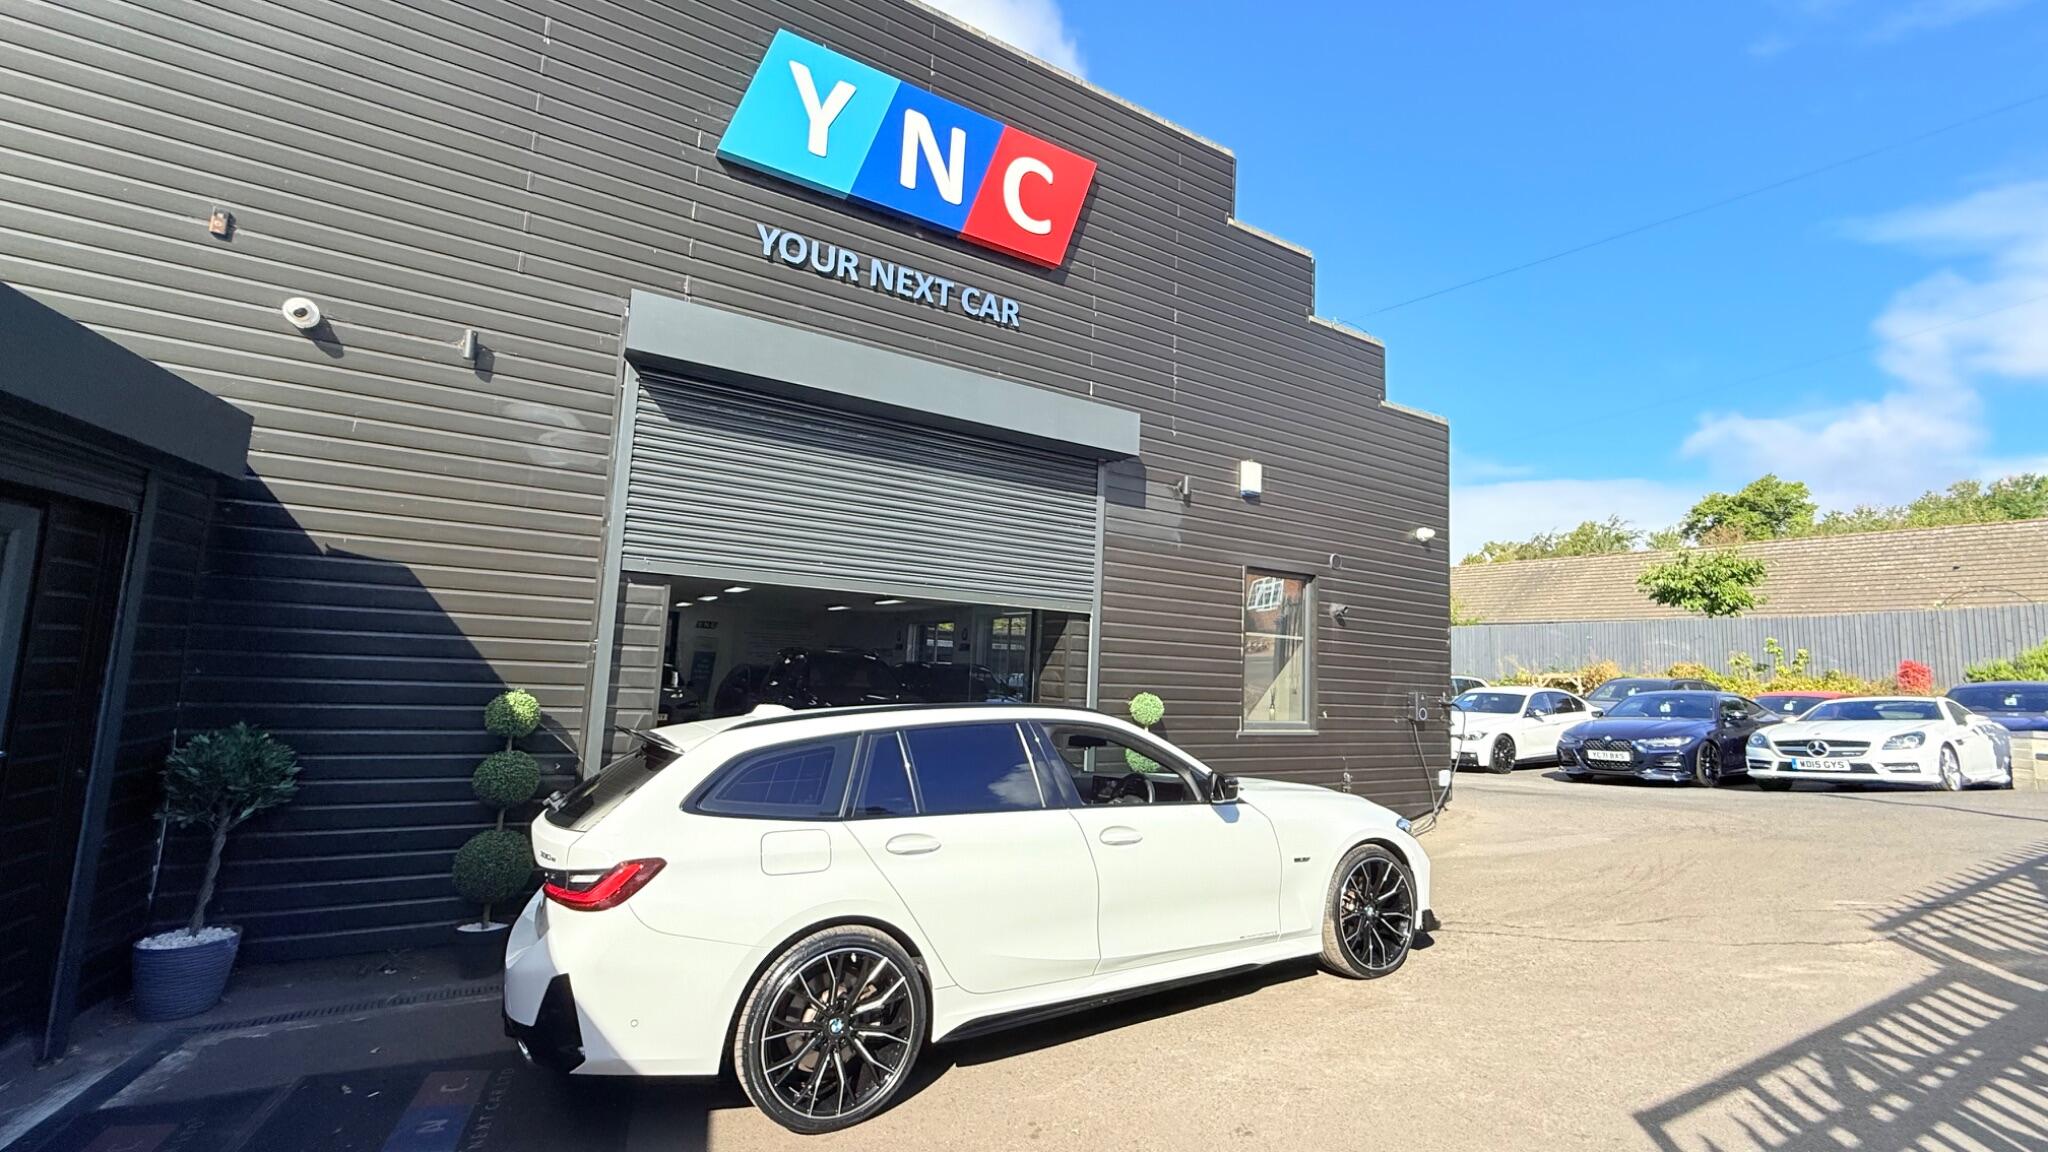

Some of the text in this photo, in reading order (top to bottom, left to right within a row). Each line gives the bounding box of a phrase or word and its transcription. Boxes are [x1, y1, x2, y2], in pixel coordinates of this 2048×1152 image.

[788, 60, 1054, 235] YNC
[756, 222, 1020, 328] YOUR NEXT CAR
[1824, 760, 1845, 769] GYS
